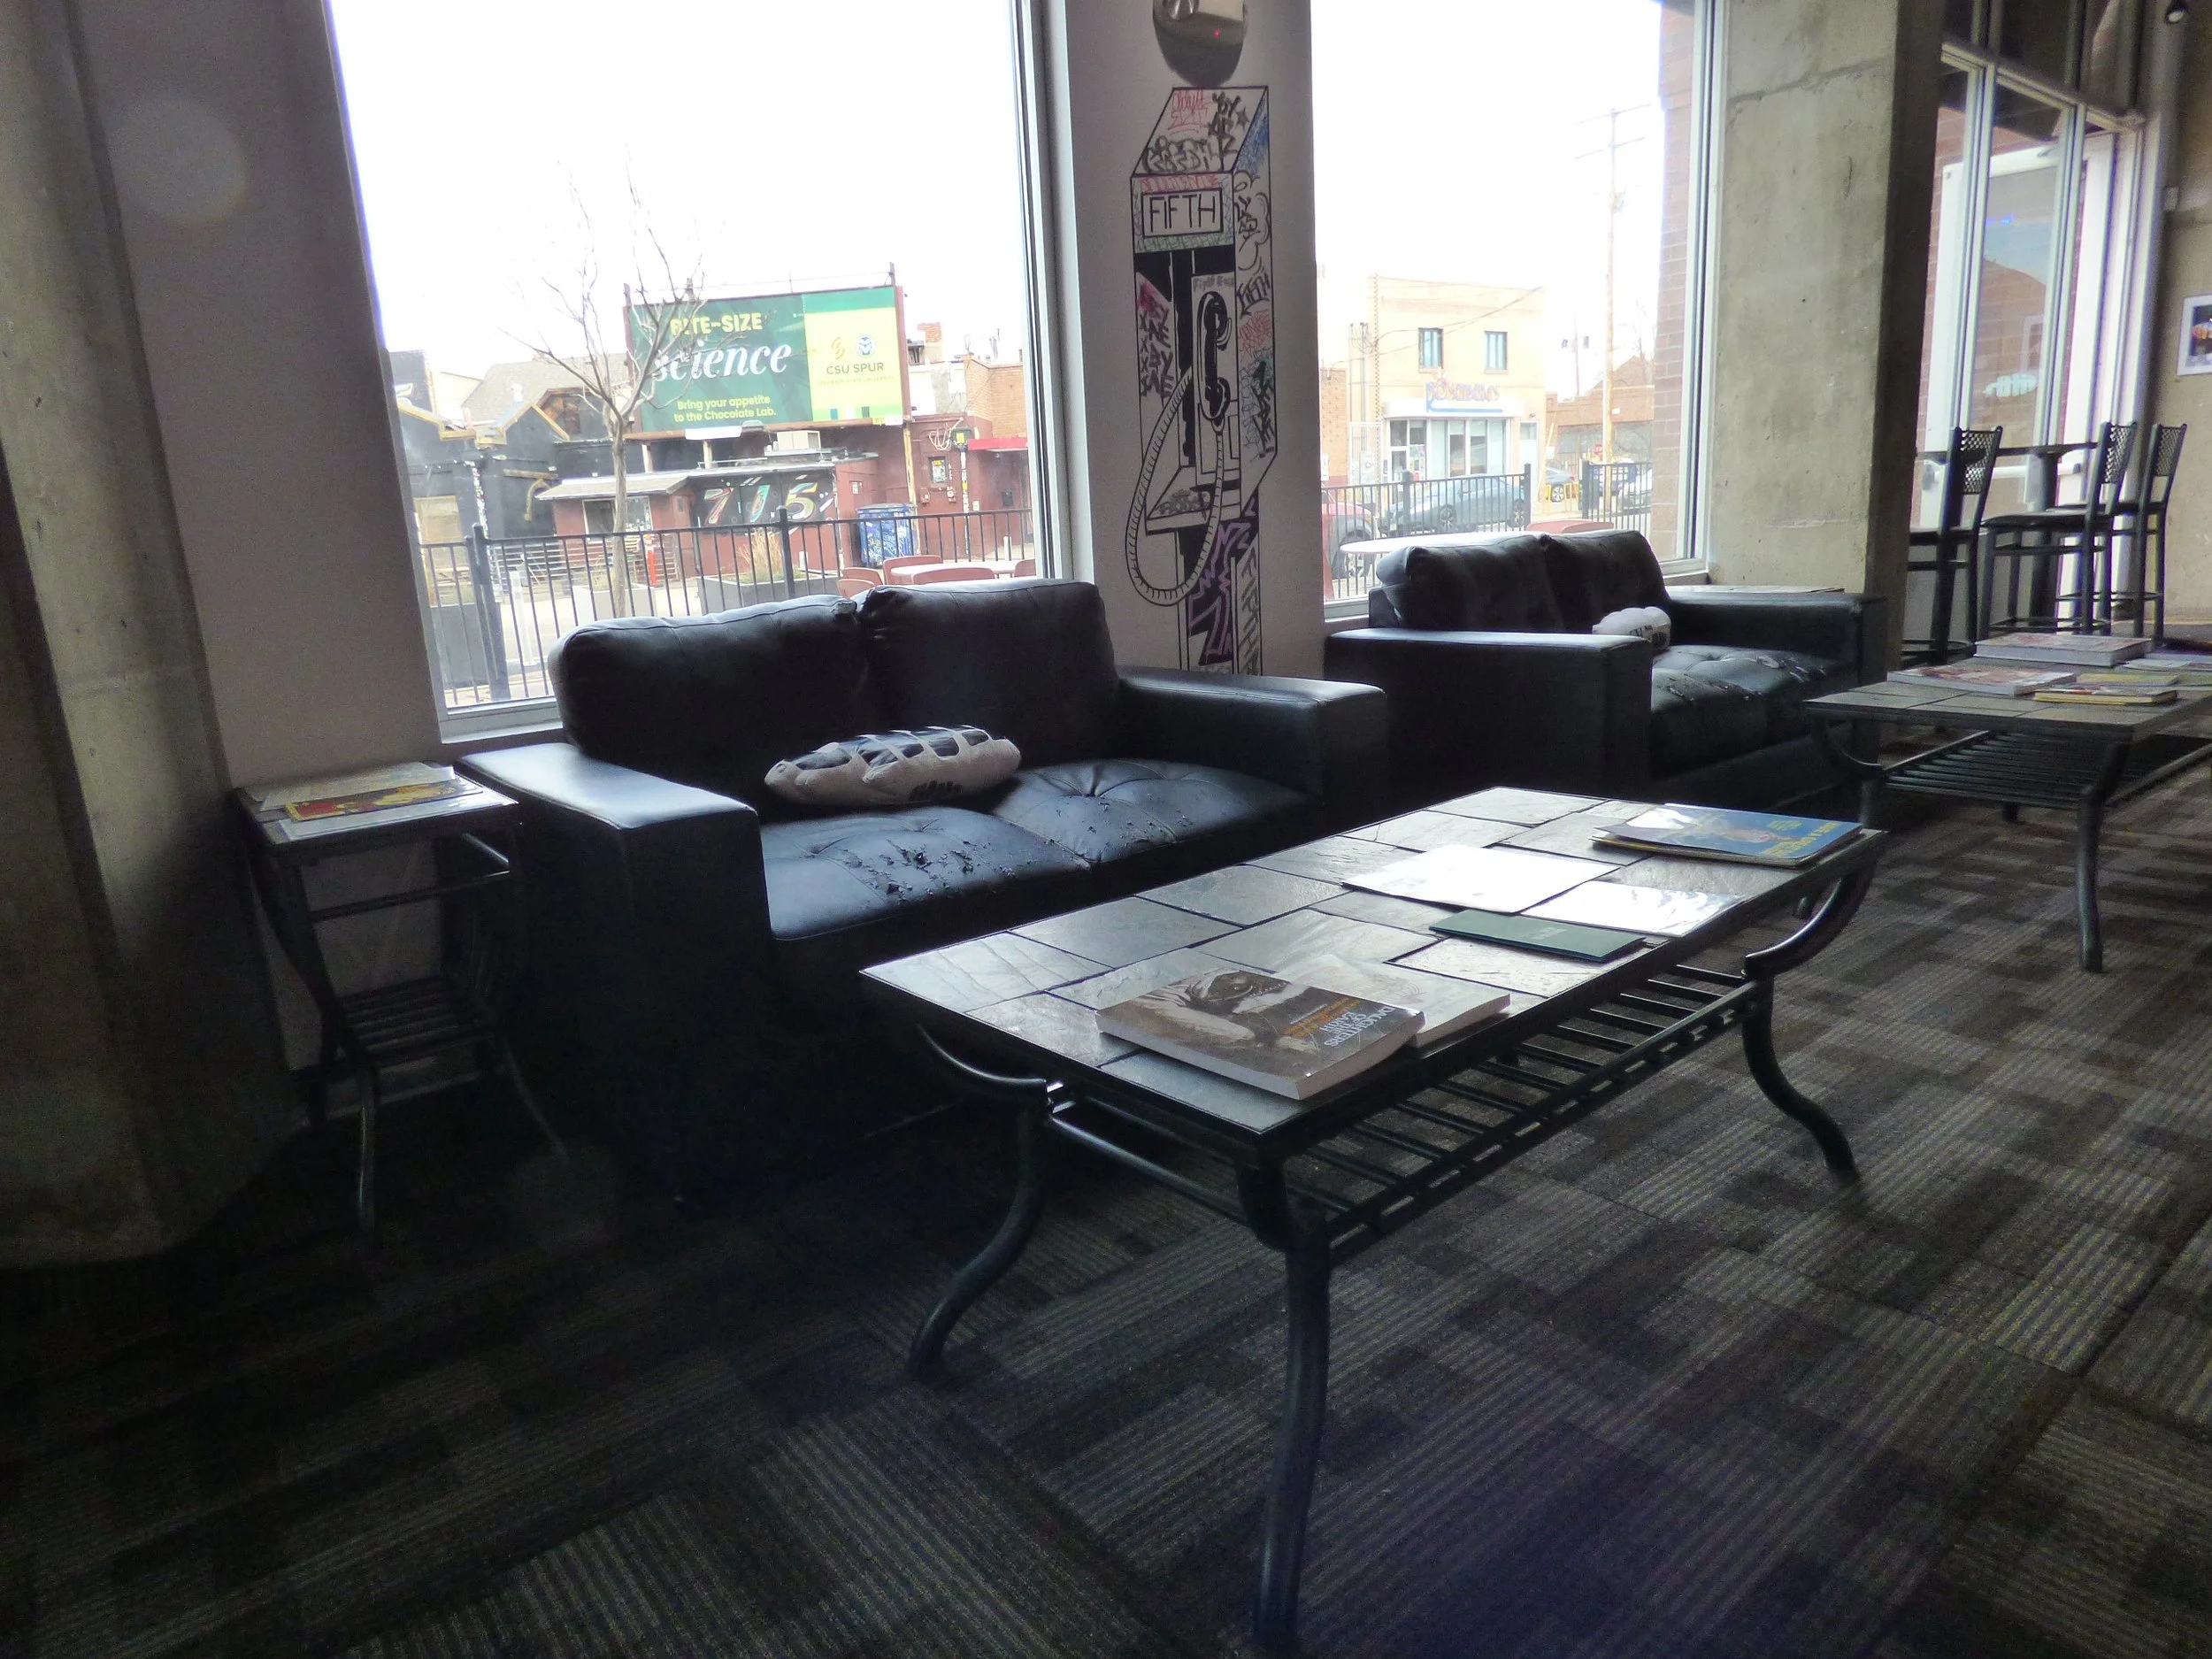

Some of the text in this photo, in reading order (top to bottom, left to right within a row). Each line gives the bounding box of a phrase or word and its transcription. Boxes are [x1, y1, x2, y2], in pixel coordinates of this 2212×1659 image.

[1149, 194, 1217, 233] FIFTH
[826, 362, 884, 375] CSU SPUR
[677, 395, 771, 411] Bring your appetite
[673, 406, 777, 422] to the Chocolate Lab.
